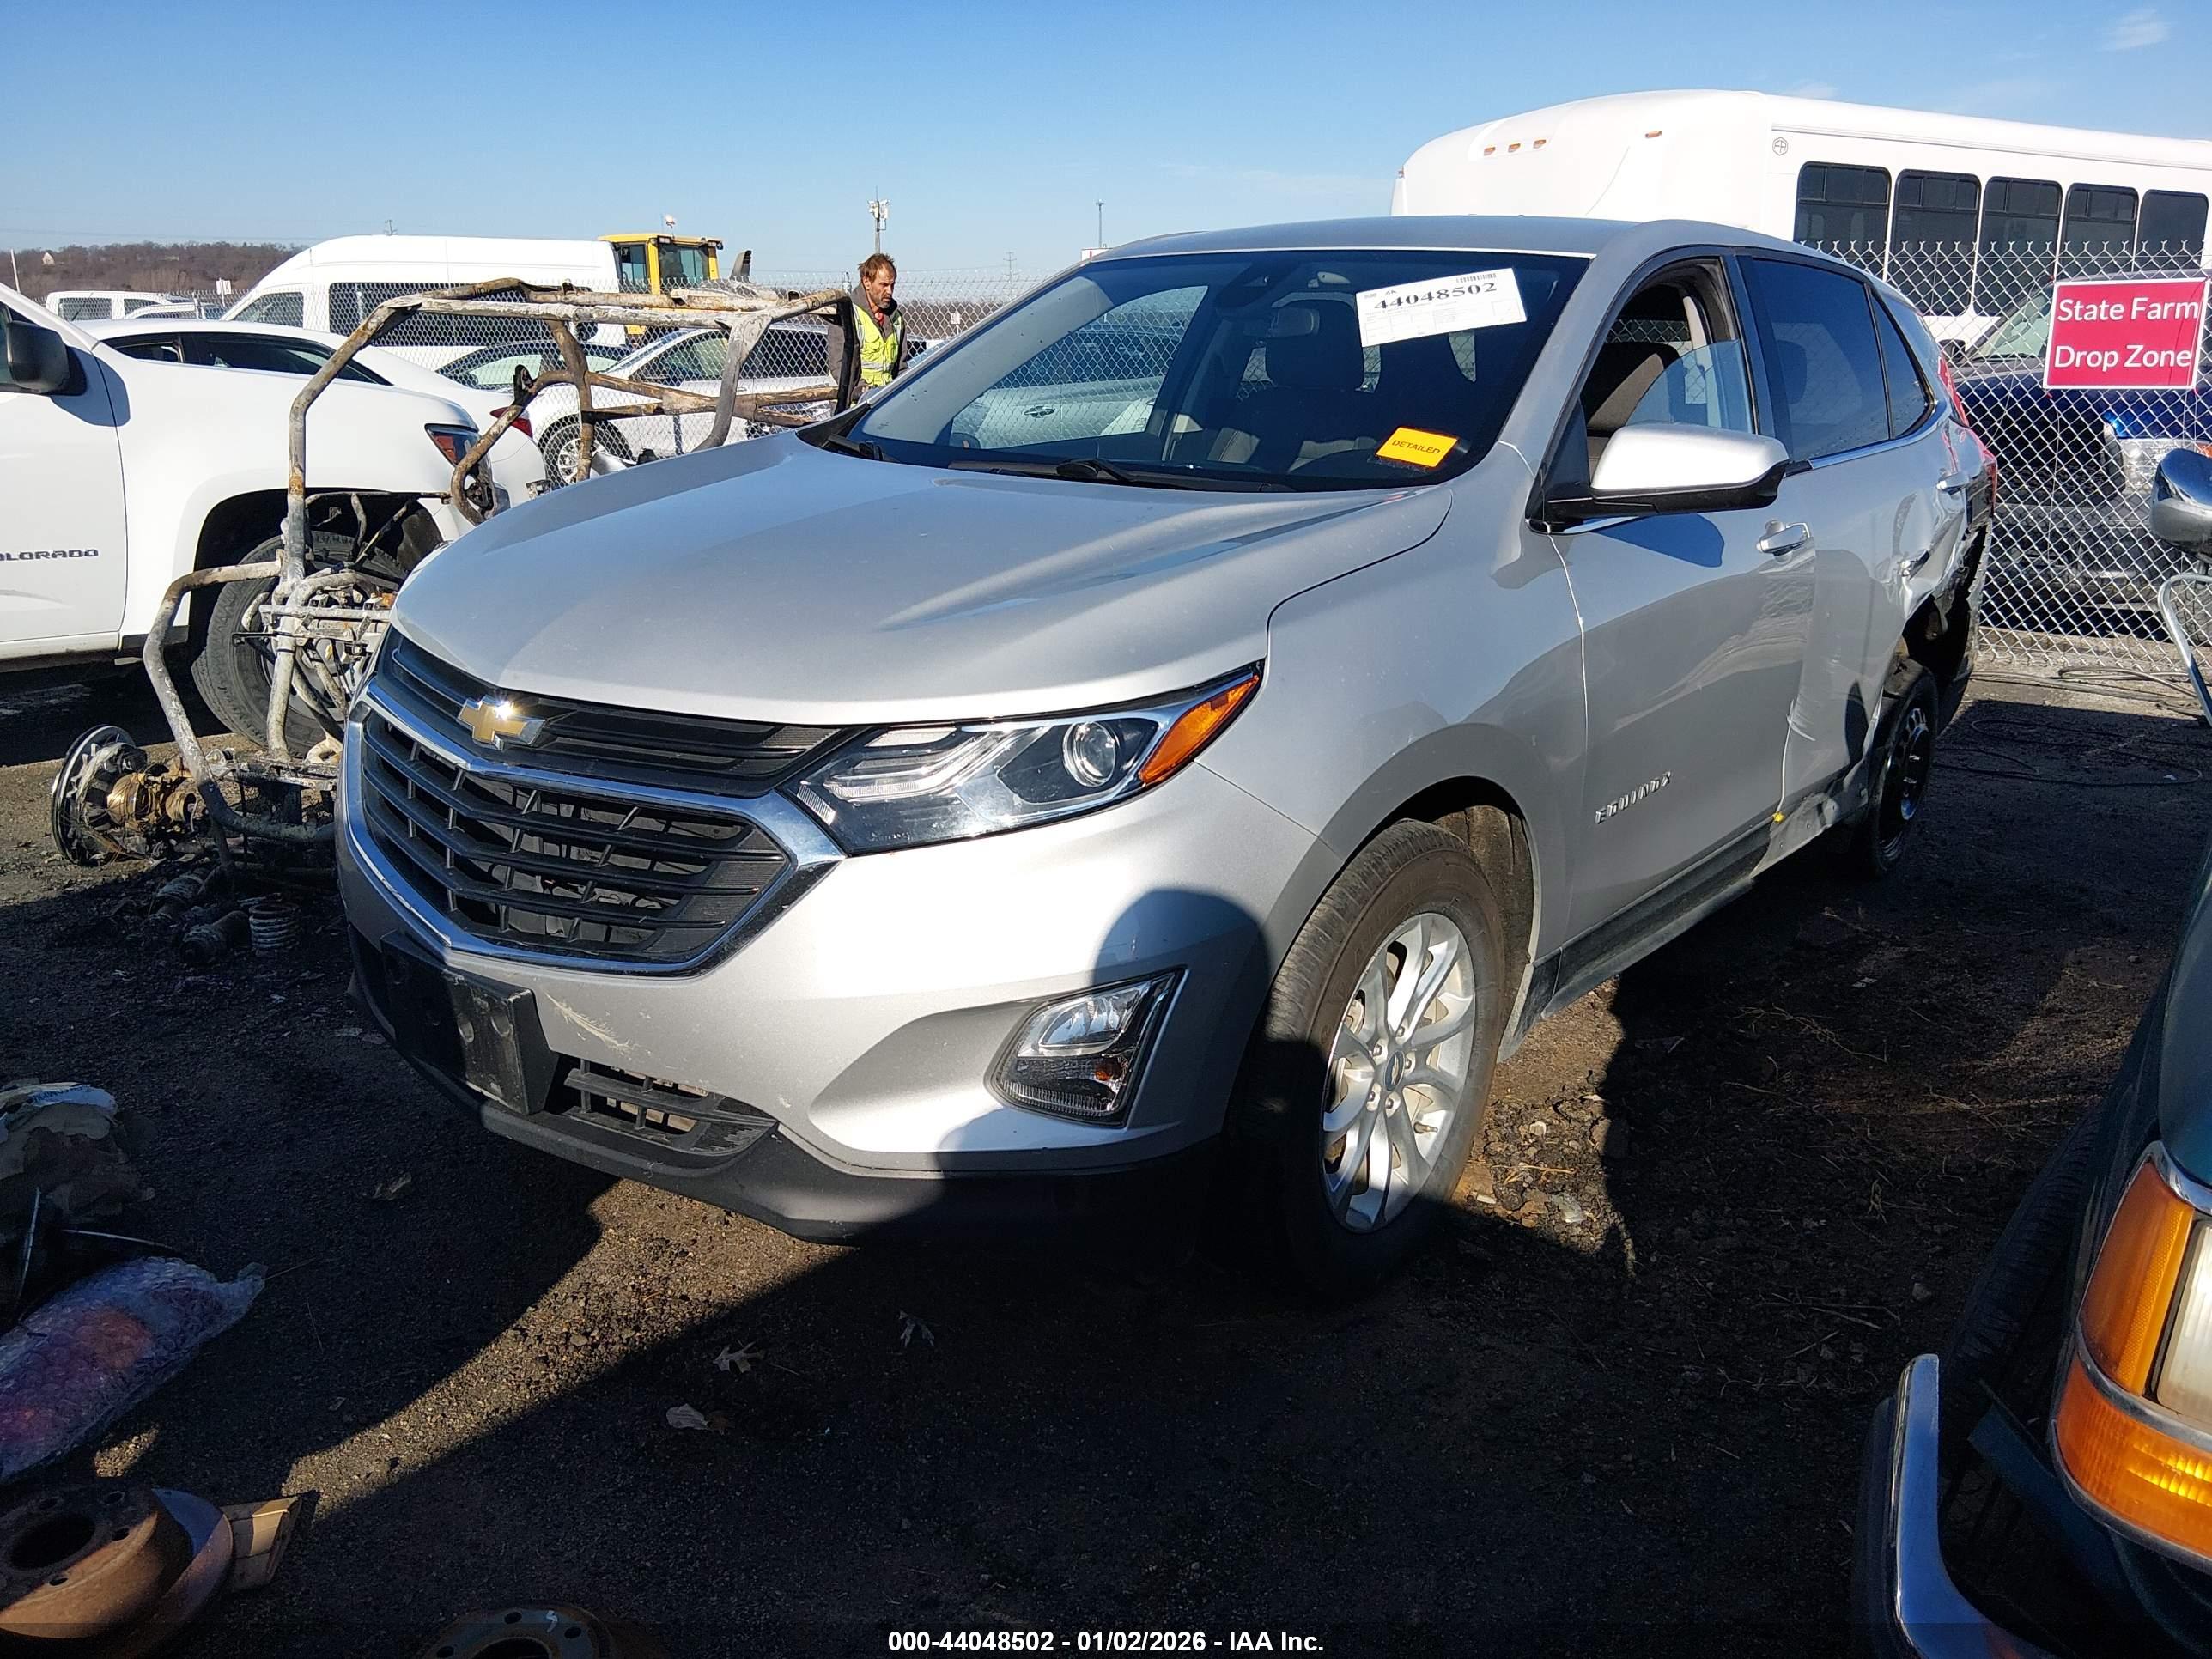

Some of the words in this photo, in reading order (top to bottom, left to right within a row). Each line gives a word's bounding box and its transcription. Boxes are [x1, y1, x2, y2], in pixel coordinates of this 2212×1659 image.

[1374, 282, 1498, 310] 44048502
[2057, 298, 2125, 322] State
[2130, 296, 2199, 321] Farm
[2054, 344, 2119, 372] Drop
[2123, 344, 2192, 368] Zone
[1391, 439, 1441, 454] DETAILED
[1595, 770, 1671, 824] EQUINOX
